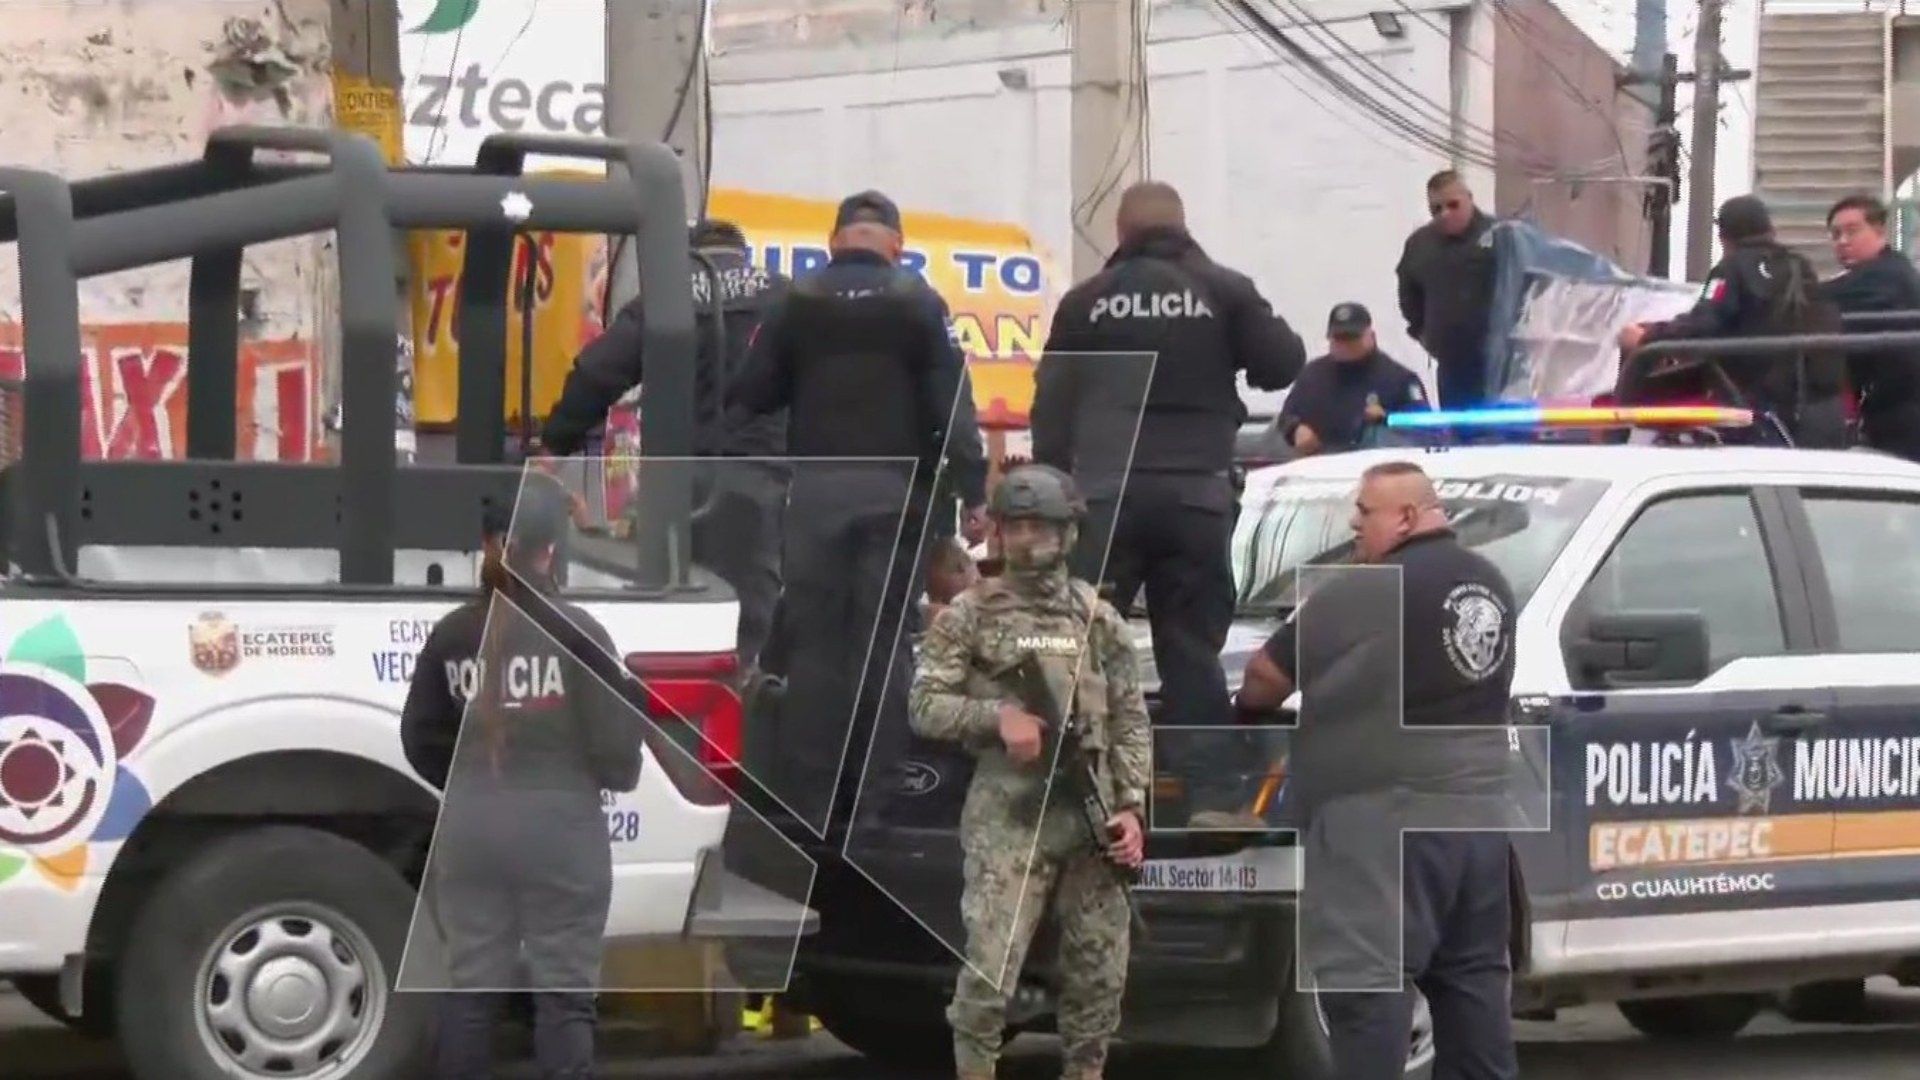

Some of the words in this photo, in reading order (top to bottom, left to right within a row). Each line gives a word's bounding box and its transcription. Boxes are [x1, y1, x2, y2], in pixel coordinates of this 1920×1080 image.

[402, 63, 606, 133] zteca
[953, 253, 1040, 292] TO
[243, 632, 334, 645] ECATEPEC
[244, 646, 261, 657] DE
[267, 646, 335, 657] MORELOS
[1586, 728, 1718, 806] POLICÍA
[1596, 822, 1774, 865] ECATEPEC
[1169, 865, 1213, 889] Sector
[1597, 882, 1627, 900] CD
[1632, 872, 1775, 898] CUAUHTÉMOC
